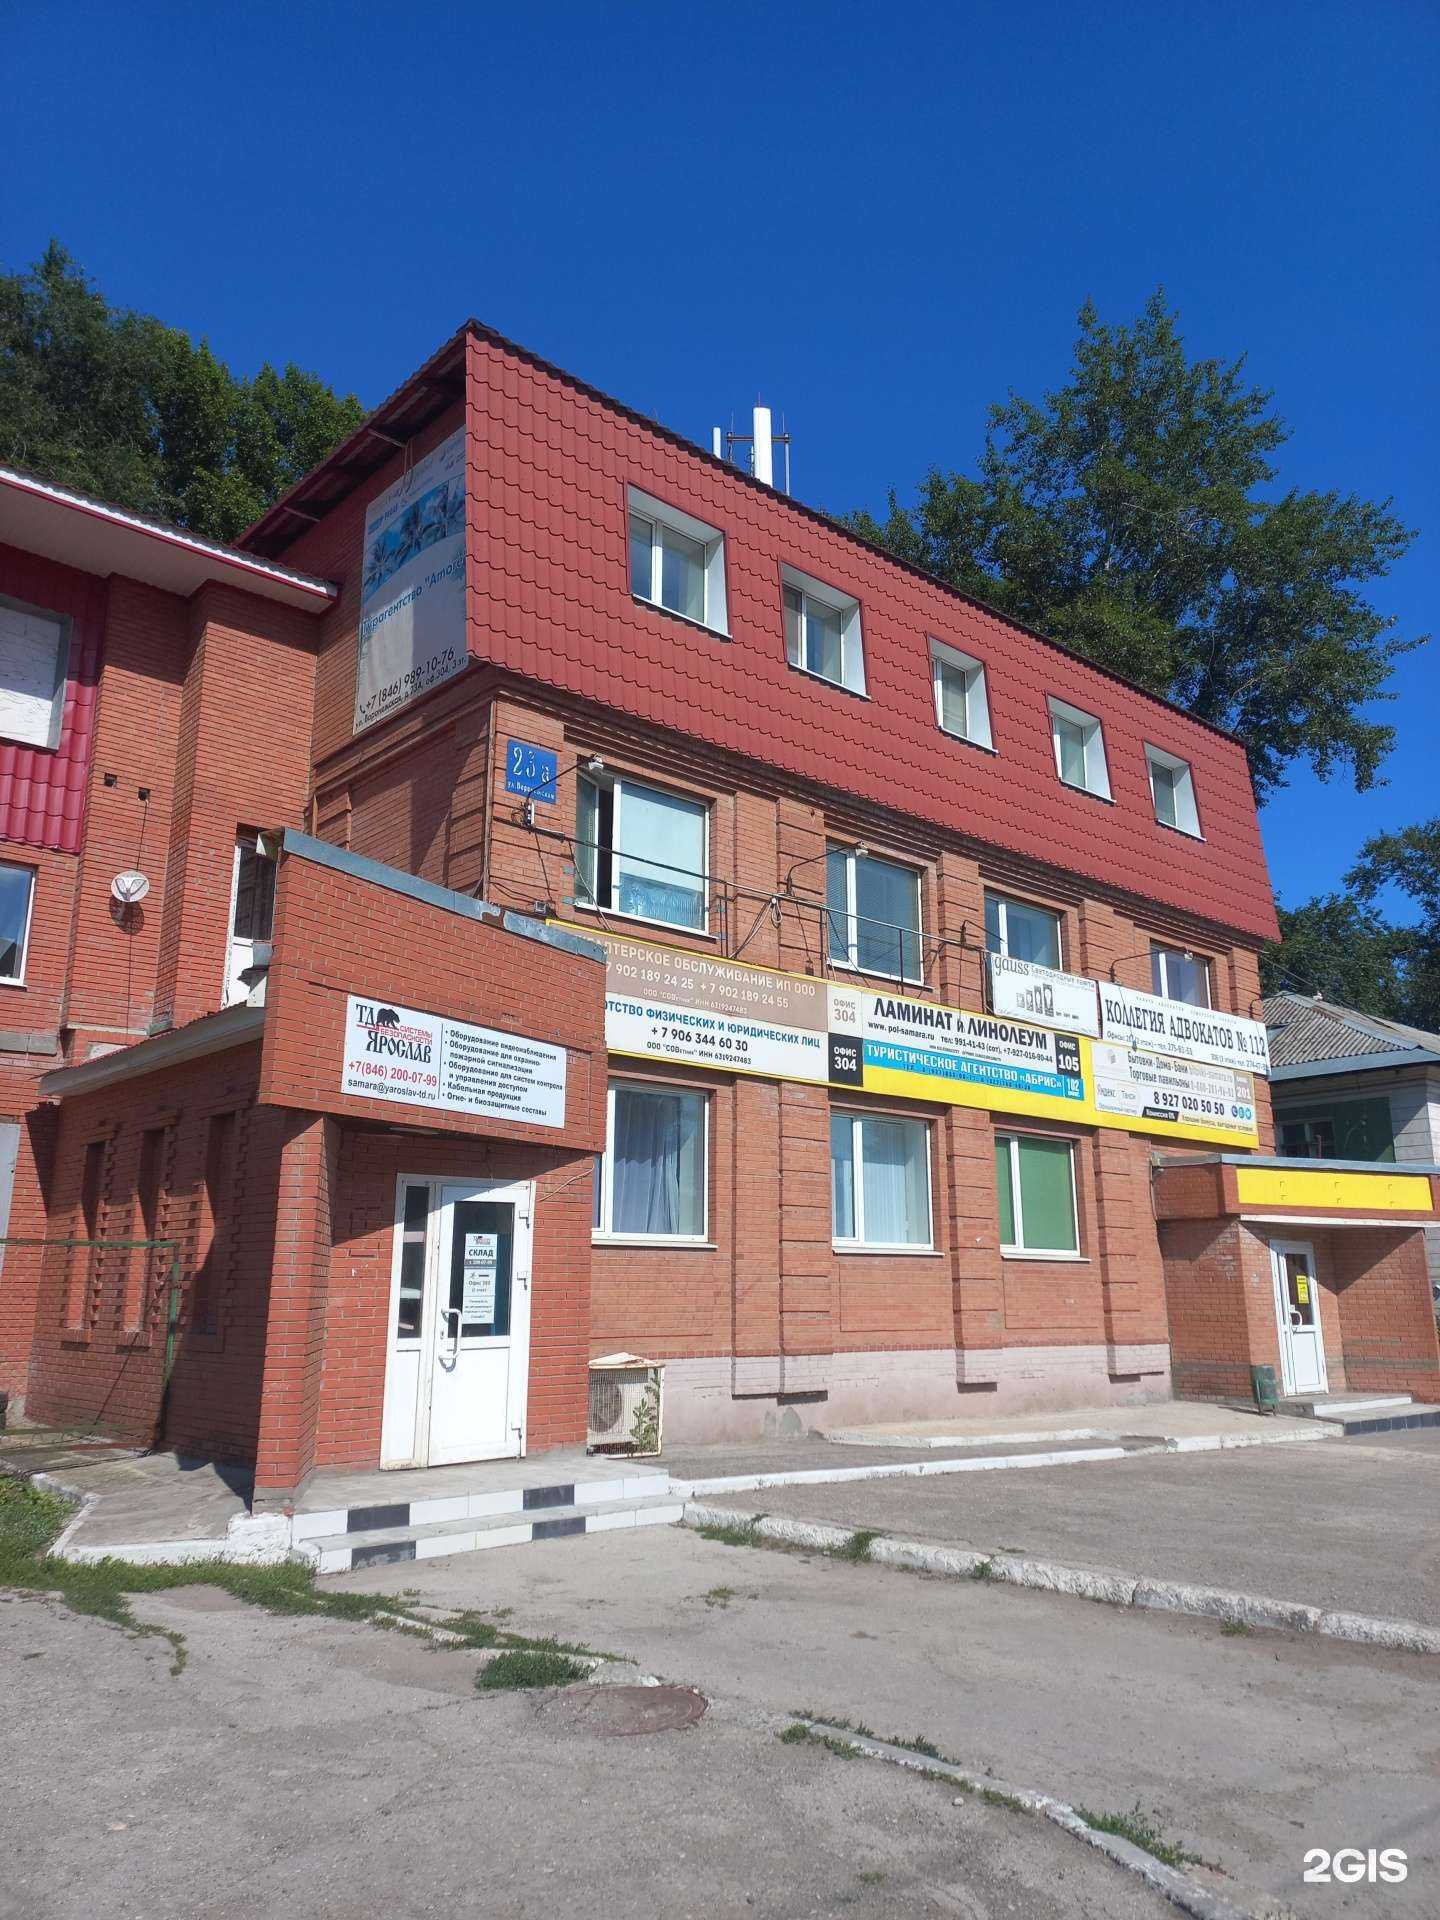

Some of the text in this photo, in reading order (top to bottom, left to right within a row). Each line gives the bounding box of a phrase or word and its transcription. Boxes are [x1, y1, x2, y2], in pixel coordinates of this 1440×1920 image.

[378, 678, 402, 707] (846)
[404, 647, 455, 687] 989-10-76
[674, 956, 773, 988] ОБСЛУЖИВАНИЕ
[776, 979, 791, 992] ИП
[794, 982, 816, 996] ООО
[994, 956, 1030, 976] gauss
[616, 963, 638, 978] 902
[640, 968, 661, 982] 189
[664, 974, 678, 986] 24
[681, 978, 694, 990] 25
[719, 984, 738, 999] 902
[741, 990, 759, 1003] 189
[762, 994, 774, 1006] 24
[777, 997, 789, 1009] 55
[355, 1003, 375, 1027] ТД
[833, 998, 856, 1010] ОФИС
[834, 1008, 856, 1024] 304
[874, 997, 953, 1031] ЛАМИНАТ
[967, 1017, 1047, 1050] ЛИНОЛЕУМ
[380, 1027, 433, 1045] БЕЗОПАСНОСТИ
[400, 1024, 433, 1039] СИСТЕМЫ
[646, 1008, 715, 1029] ФИЗИЧЕСКИХ
[717, 1021, 725, 1031] И
[727, 1022, 799, 1044] ЮРИДИЧЕСКИХ
[801, 1036, 821, 1049] ЛИЦ
[1105, 999, 1165, 1034] КОЛЛЕГИЯ
[1170, 1015, 1234, 1049] АДВОКАТОВ
[1236, 1030, 1248, 1052] №
[1248, 1034, 1267, 1057] 112
[365, 1030, 432, 1064] ЯРОСЛАВ
[449, 1040, 499, 1057] Оборудование
[500, 1051, 513, 1061] для
[450, 1029, 557, 1061] Оборудование видеонаблюдения
[671, 1029, 692, 1042] 906
[695, 1032, 716, 1046] 344
[719, 1036, 732, 1049] 60
[735, 1039, 748, 1051] 30
[954, 1037, 985, 1050] 991-41-43
[1059, 1040, 1076, 1051] ОФИС
[449, 1051, 533, 1075] пожарной сигнализации
[647, 1041, 661, 1050] ООО
[698, 1050, 713, 1058] ИНН
[714, 1052, 752, 1065] 6319247483
[833, 1046, 857, 1058] ОФИС
[1058, 1054, 1080, 1072] 105
[348, 1060, 438, 1087] +7(846) 200-07-99
[834, 1056, 857, 1072] 304
[867, 1044, 958, 1071] ТУРИСТИЧЕСКОЕ
[960, 1061, 1018, 1081] АГЕНТСТВО
[1020, 1072, 1063, 1088] «АБРИС»
[448, 1060, 563, 1091] Оборудование для систем контроля
[455, 1074, 497, 1087] управления
[498, 1083, 528, 1094] доступом
[1066, 1078, 1080, 1092] 102
[1129, 1066, 1158, 1083] Торговые
[1158, 1074, 1191, 1089] павильоны
[348, 1078, 436, 1100] samara@yaroslav-td.ru
[447, 1081, 521, 1102] Кабельная продукция
[1236, 1086, 1252, 1100] 201
[474, 1096, 520, 1111] биозащитные
[521, 1106, 547, 1116] составы
[1153, 1091, 1225, 1116] 8 927 020 50 50
[468, 1249, 494, 1257] СКЛАД
